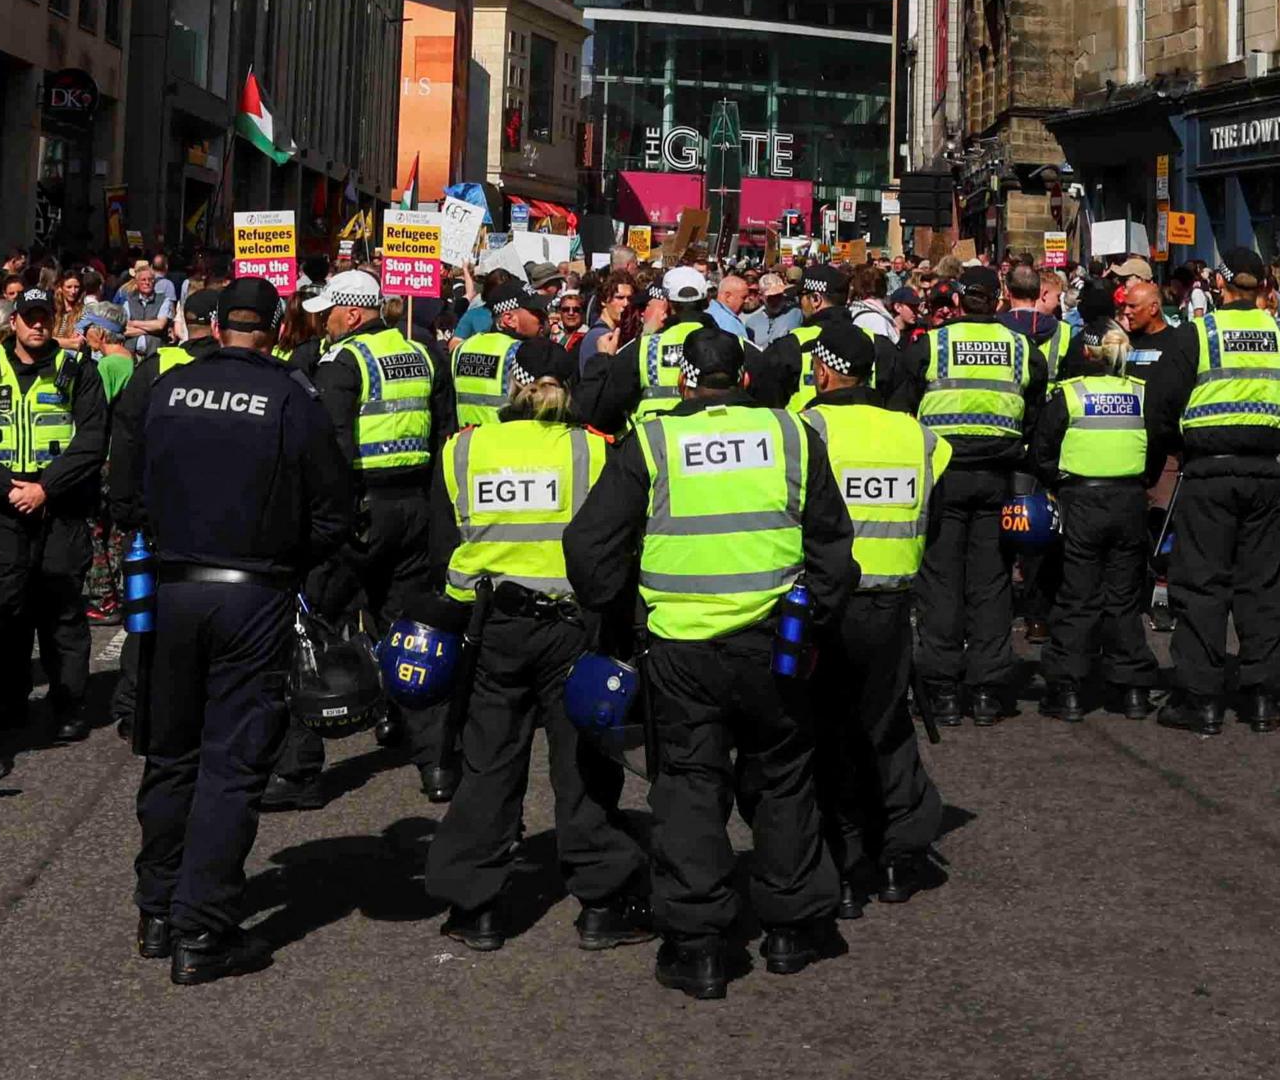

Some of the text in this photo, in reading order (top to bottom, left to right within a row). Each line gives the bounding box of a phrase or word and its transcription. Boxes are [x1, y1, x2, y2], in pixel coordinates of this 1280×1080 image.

[1210, 124, 1238, 151] THE
[645, 126, 661, 169] THE
[238, 228, 292, 243] Refugees
[387, 226, 439, 242] Refugees
[238, 242, 290, 254] welcome
[387, 241, 436, 254] welcome
[239, 260, 289, 275] Stop the
[385, 258, 434, 274] Stop the
[385, 272, 433, 289] far right
[956, 341, 1007, 353] HEDDLU
[381, 352, 420, 366] HEDDL
[461, 353, 496, 367] HEDDLU
[956, 354, 1009, 366] POLICE
[460, 365, 492, 377] POLICE
[169, 386, 269, 417] POLICE
[1089, 394, 1135, 406] HEDDLU
[1094, 404, 1133, 415] POLICE
[683, 438, 769, 467] EGT 1
[478, 479, 557, 503] EGT 1
[846, 476, 916, 500] EGT 1
[1001, 516, 1030, 532] WO
[391, 631, 444, 658] 1103
[398, 663, 427, 686] LB
